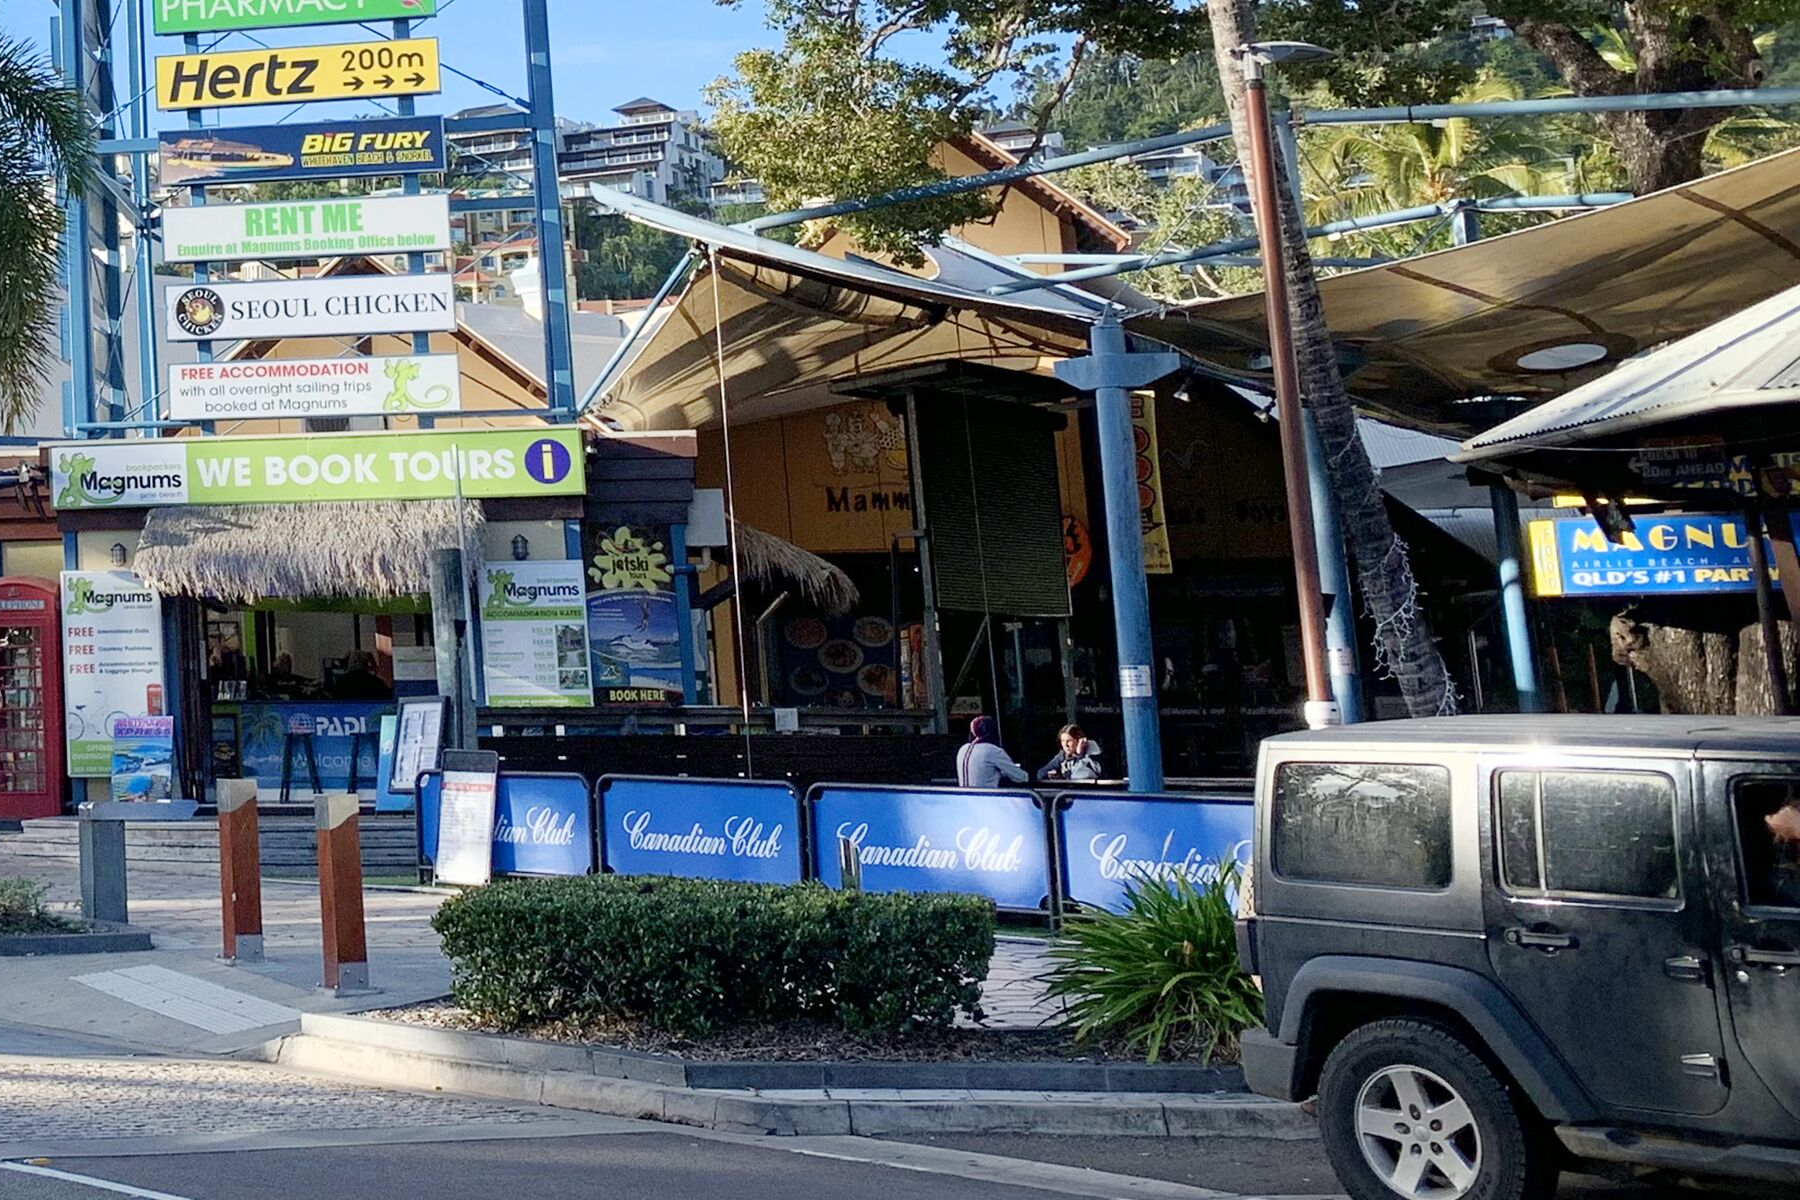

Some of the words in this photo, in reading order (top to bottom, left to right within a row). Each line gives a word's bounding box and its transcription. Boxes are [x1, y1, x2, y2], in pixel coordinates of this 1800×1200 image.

[341, 47, 425, 72] 200m
[169, 54, 320, 103] Hertz
[357, 130, 431, 151] FURY
[301, 153, 354, 168] WHITEHAVEN
[356, 151, 385, 165] BEACH
[395, 148, 434, 163] SNORKEL
[244, 205, 316, 237] RENT
[321, 202, 363, 233] ME
[177, 243, 223, 257] Enquire
[225, 242, 238, 255] at
[241, 240, 302, 255] Magnums
[303, 237, 354, 251] Booking
[358, 235, 395, 248] Office
[397, 232, 436, 246] below
[181, 289, 217, 305] SEOUL
[231, 298, 317, 321] SEOUL
[325, 291, 448, 316] CHICKEN
[181, 367, 215, 380] FREE
[219, 362, 369, 379] ACCOMMODATION
[179, 384, 205, 397] with
[209, 383, 226, 396] all
[230, 380, 293, 398] overnight
[296, 380, 340, 397] sailing
[342, 379, 372, 395] trips
[205, 399, 257, 413] booked
[261, 398, 277, 411] at
[279, 397, 348, 413] Magnums
[196, 457, 252, 488] WE
[265, 453, 379, 488] BOOK
[388, 448, 516, 482] TOURS
[80, 470, 182, 495] Magnums
[611, 556, 649, 575] jetski
[1572, 559, 1633, 569] AIRLIE
[1572, 570, 1649, 587] QLD'S
[1654, 569, 1686, 584] #1
[82, 590, 153, 607] Magnums
[503, 582, 580, 601] Magnums
[68, 627, 94, 637] FREE
[69, 645, 95, 655] FREE
[69, 663, 95, 674] FREE
[609, 689, 638, 701] BOOK
[640, 689, 665, 701] HERE
[315, 716, 367, 737] PADI
[622, 810, 728, 855] Canadian
